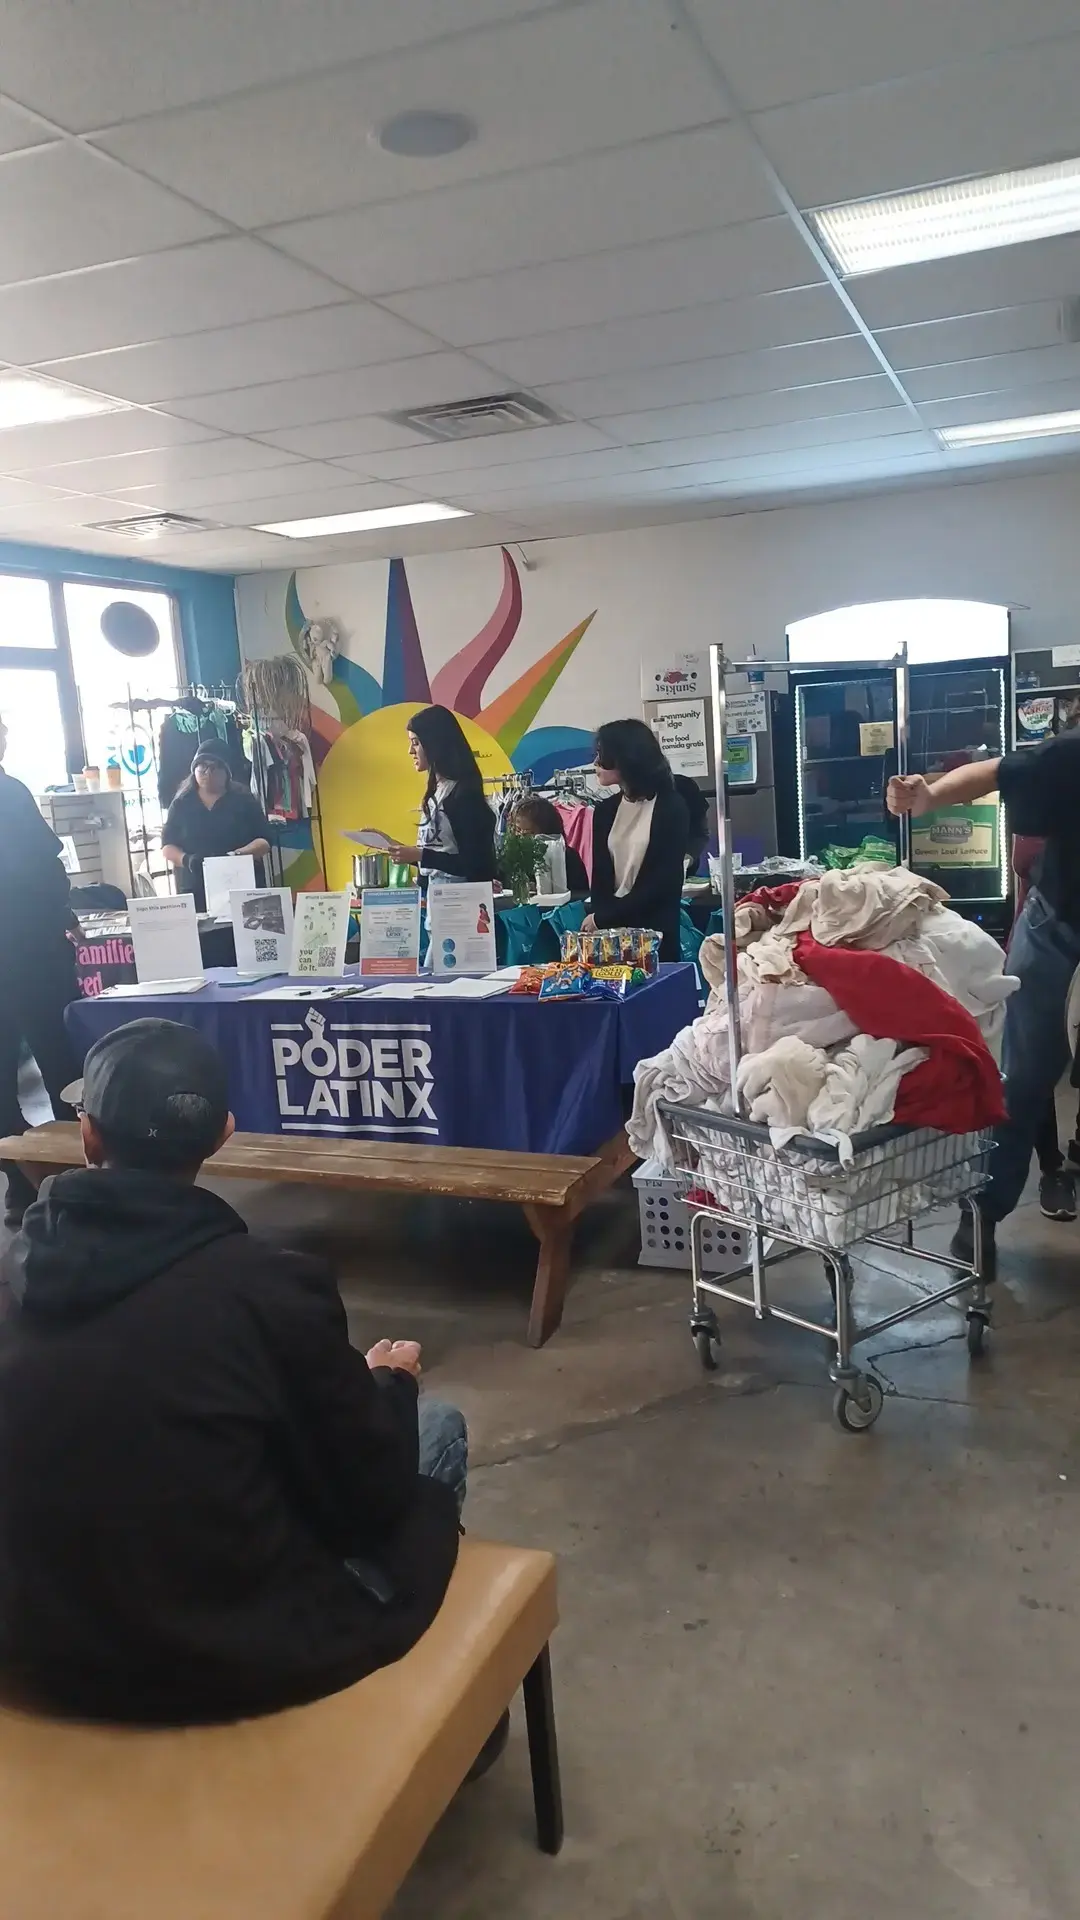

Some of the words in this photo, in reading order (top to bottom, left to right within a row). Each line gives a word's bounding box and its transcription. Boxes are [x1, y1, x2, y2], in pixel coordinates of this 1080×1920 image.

[656, 683, 696, 694] Sunkist
[667, 719, 683, 729] idge
[661, 735, 674, 743] free
[675, 734, 690, 742] food
[662, 742, 685, 750] comida
[686, 740, 704, 749] gratis
[930, 825, 972, 835] MANN'S
[941, 847, 958, 855] Leaf
[960, 847, 988, 855] Lettuce
[79, 939, 134, 964] amilie
[299, 949, 313, 957] you
[272, 1038, 433, 1078] PODER
[277, 1079, 437, 1120] LATINX
